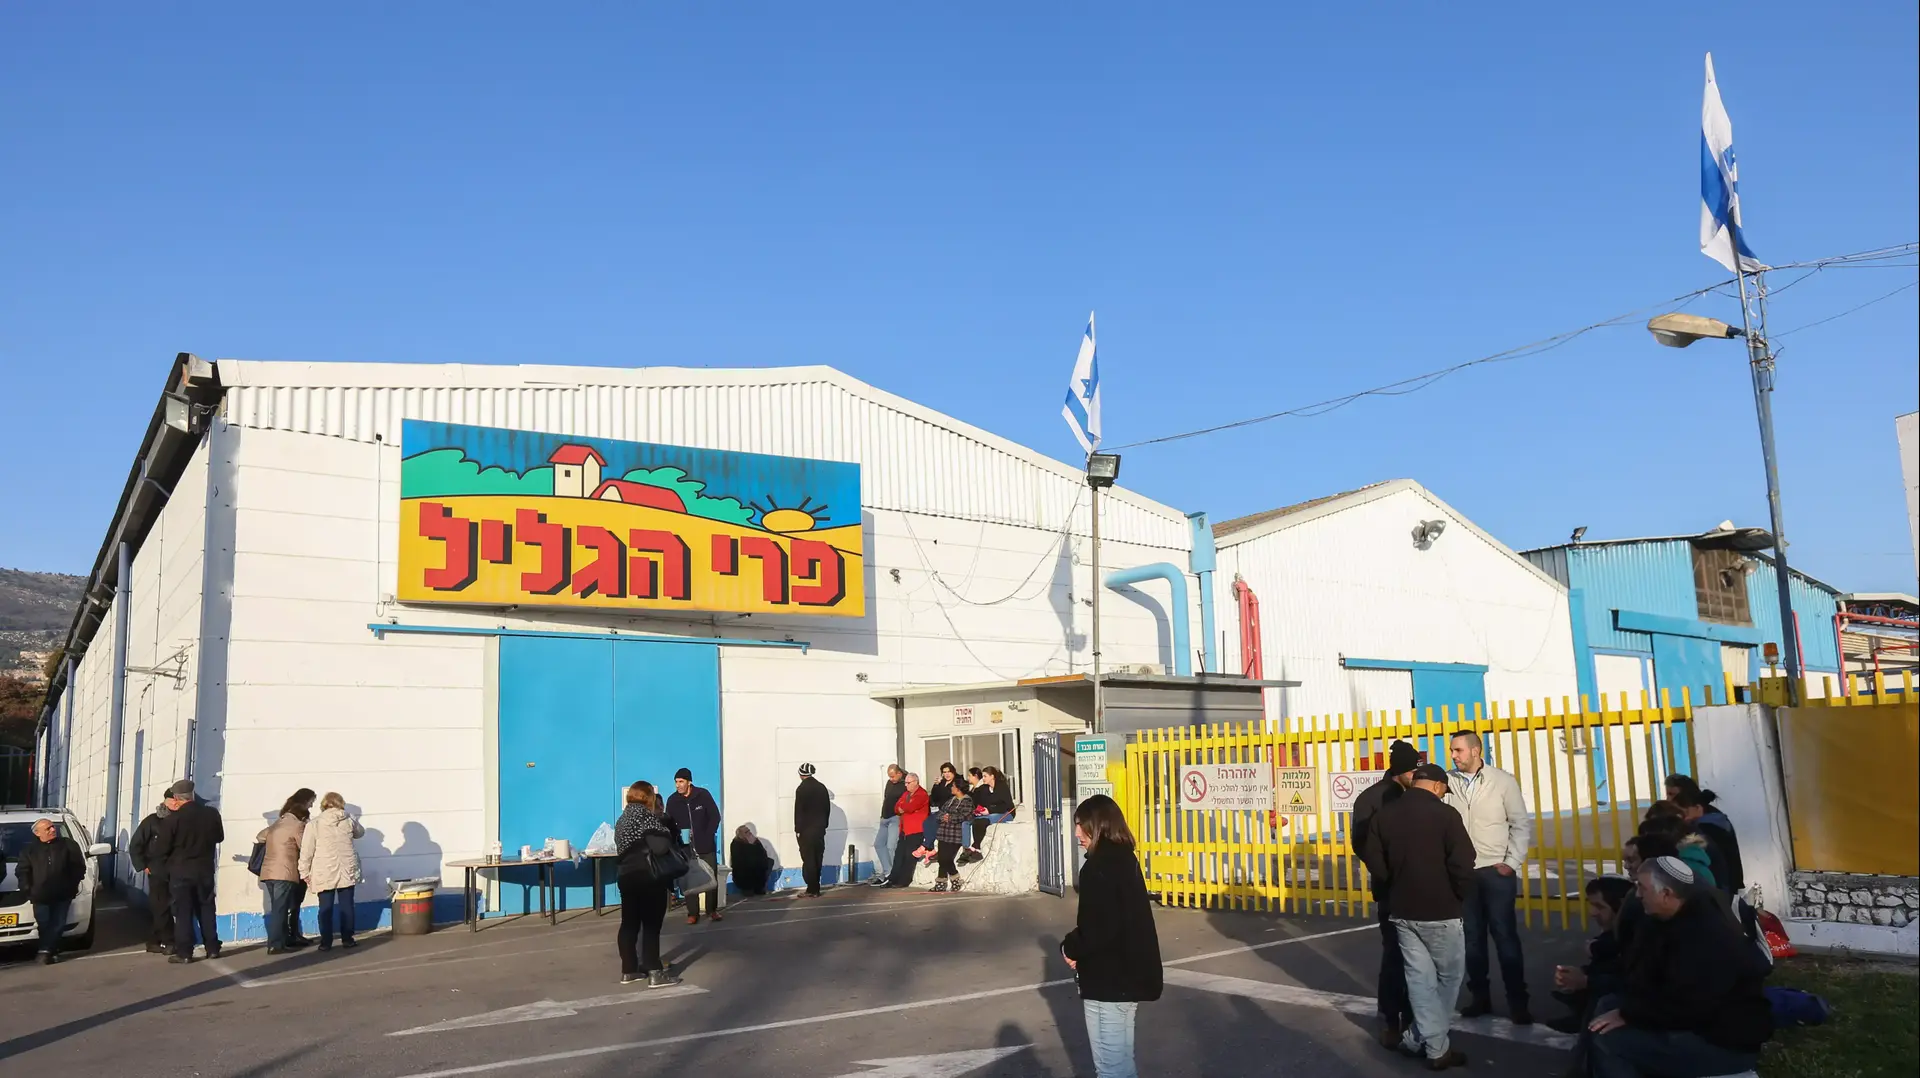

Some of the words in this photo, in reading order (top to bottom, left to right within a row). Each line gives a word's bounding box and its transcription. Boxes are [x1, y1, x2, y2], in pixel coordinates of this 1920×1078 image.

[419, 501, 692, 601] הגליל
[711, 534, 846, 606] פרי
[1218, 768, 1257, 779] אזהרה!
[1282, 770, 1310, 780] מלגזות
[1281, 781, 1311, 789] בעבודה
[1353, 776, 1370, 785] אסור
[1209, 784, 1219, 792] רגל
[1220, 784, 1239, 792] להולכי
[1259, 784, 1268, 793] אין
[1211, 796, 1235, 805] החשמלי
[1237, 797, 1253, 805] השער
[1256, 797, 1267, 806] דרך
[1290, 804, 1312, 812] הישמר
